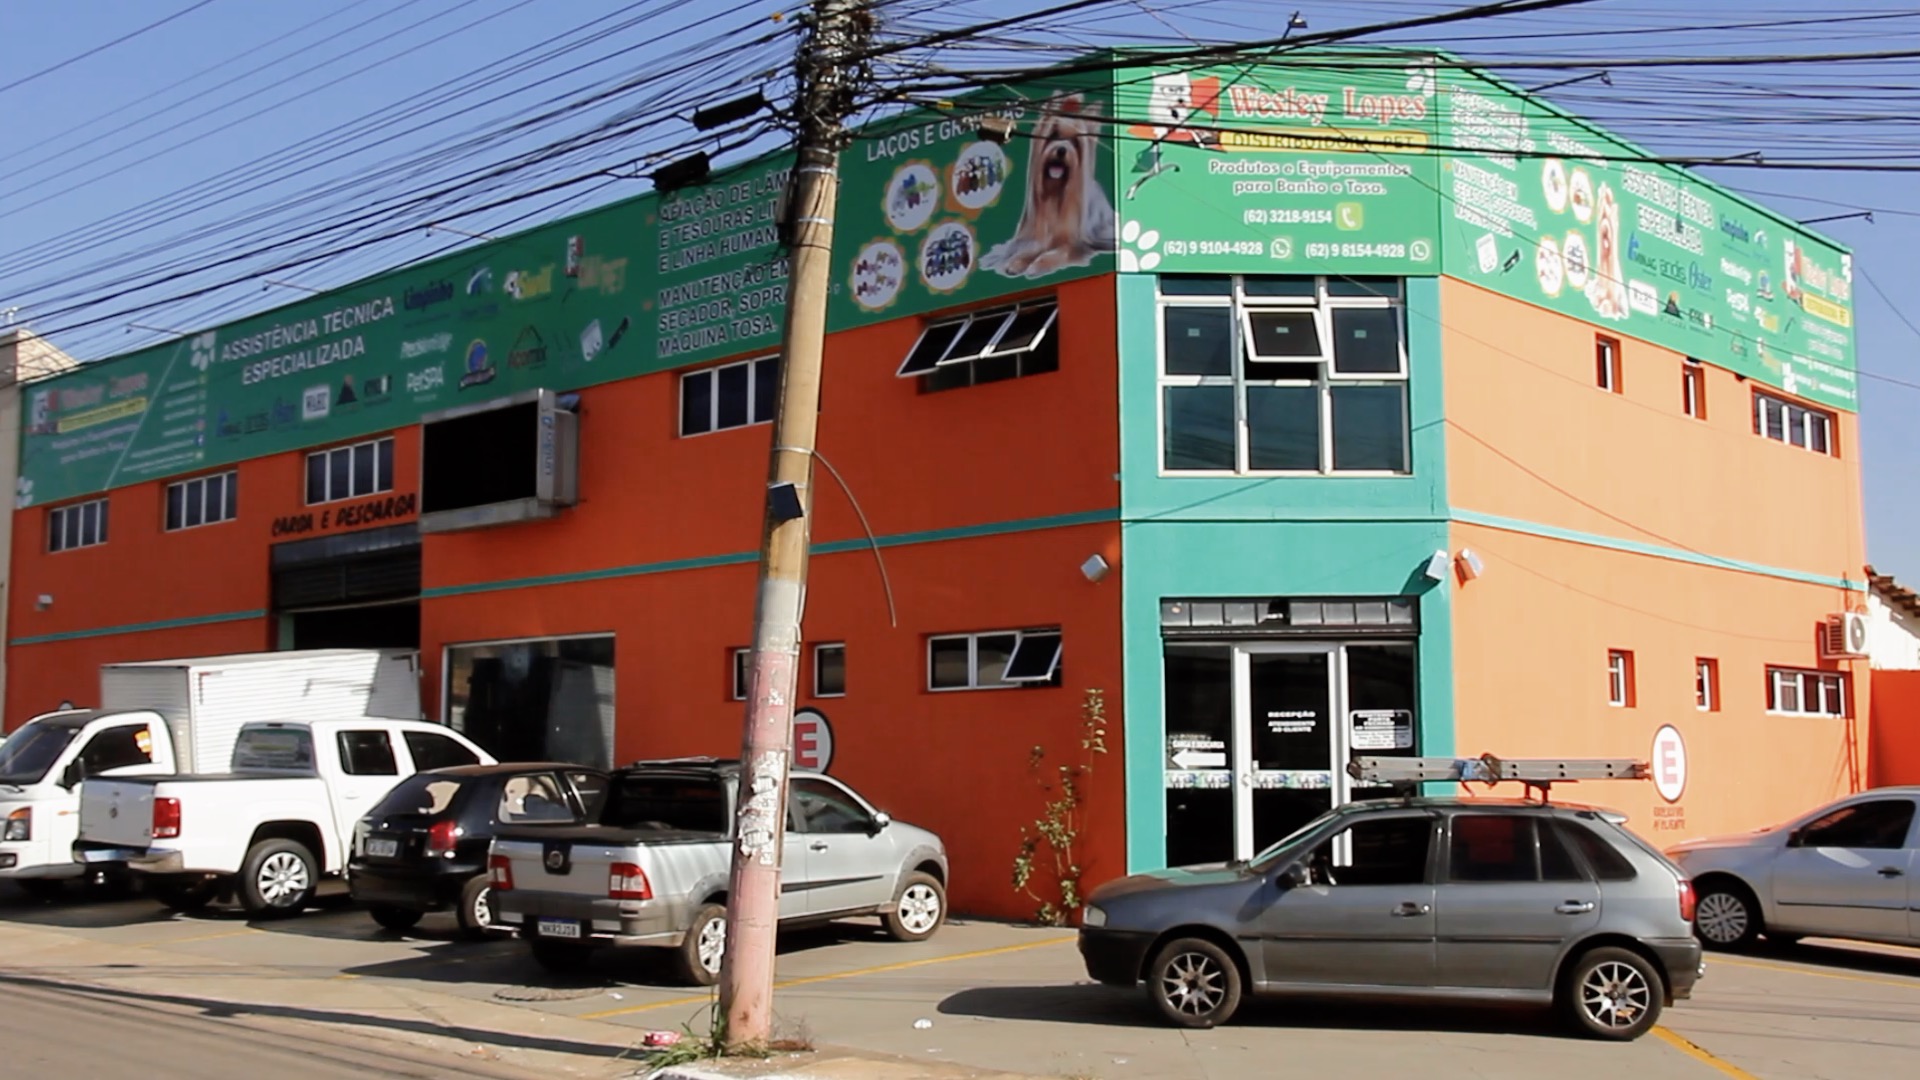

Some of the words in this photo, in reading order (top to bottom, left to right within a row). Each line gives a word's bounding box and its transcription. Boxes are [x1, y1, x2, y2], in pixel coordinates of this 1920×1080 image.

[1227, 84, 1328, 124] Wesley
[1342, 85, 1427, 125] Lopes
[866, 129, 921, 162] LAÇOS
[925, 123, 935, 145] E
[730, 182, 750, 203] DE
[755, 168, 791, 197] LÂM
[1208, 159, 1279, 176] Produtos
[1282, 163, 1294, 175] e
[1297, 160, 1411, 178] Equipamentos
[1233, 181, 1273, 196] para
[1276, 179, 1328, 194] Banho
[1331, 182, 1343, 194] e
[1345, 180, 1388, 195] Tosa.
[659, 229, 670, 250] E
[672, 205, 754, 244] TESOURAS
[1243, 208, 1268, 226] (62)
[1269, 209, 1332, 224] 3218-9154
[659, 253, 670, 275] E
[671, 242, 717, 272] LINHA
[1163, 241, 1187, 258] (62)
[1189, 242, 1198, 255] 9
[1199, 242, 1263, 256] 9104-4928
[1305, 242, 1329, 259] (62)
[1331, 244, 1339, 257] 9
[1341, 244, 1405, 258] 8154-4928
[658, 262, 765, 310] MANUTENÇÃO
[739, 284, 787, 315] SOPR
[221, 319, 319, 363] ASSISTÊNCIA
[323, 296, 395, 335] TÉCNICA
[657, 324, 727, 360] MÁQUINA
[241, 335, 366, 386] ESPECIALIZADA
[794, 722, 818, 768] E
[1661, 740, 1678, 784] E
